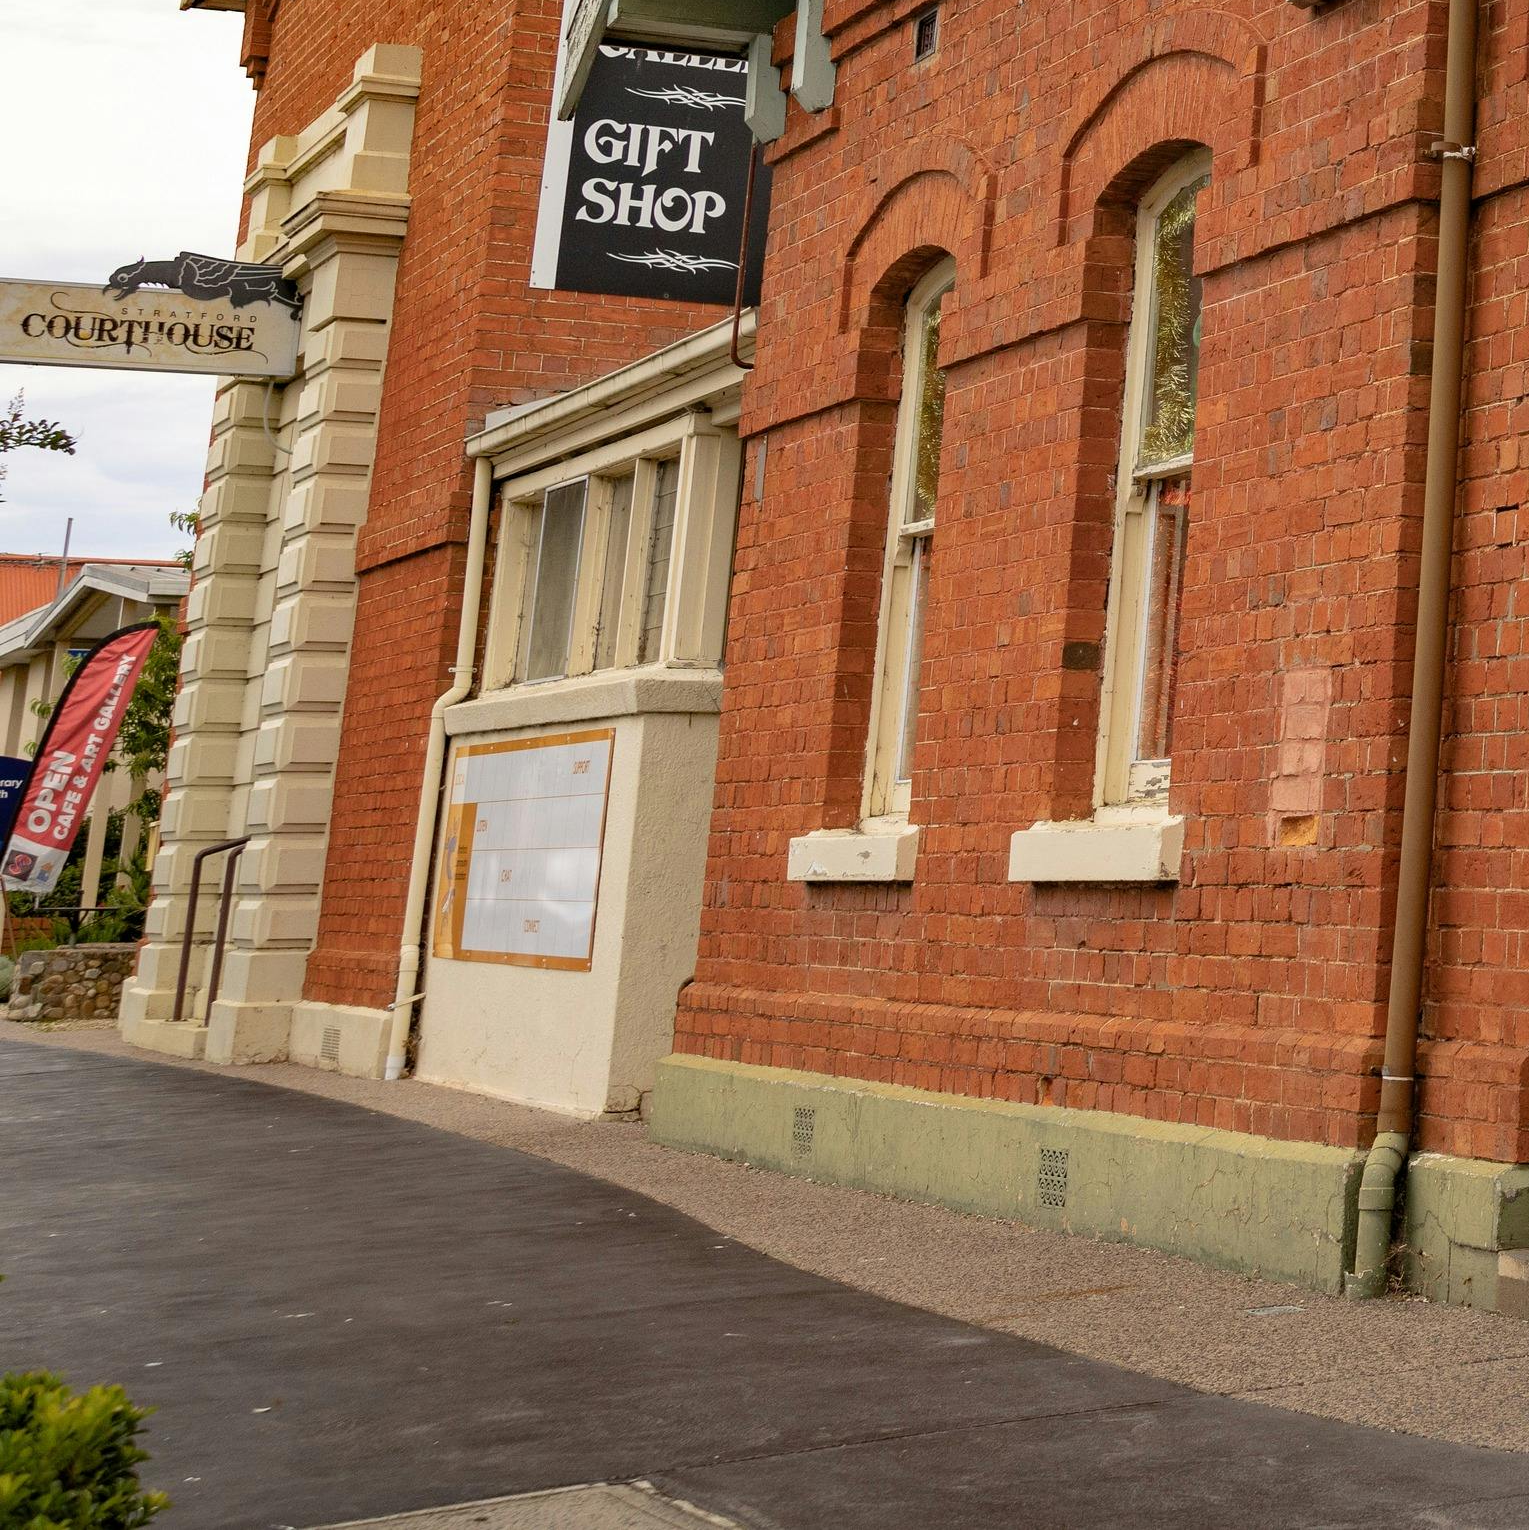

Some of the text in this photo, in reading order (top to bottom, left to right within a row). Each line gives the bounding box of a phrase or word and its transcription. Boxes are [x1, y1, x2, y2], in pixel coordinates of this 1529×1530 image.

[584, 118, 715, 177] GIFT
[575, 177, 727, 234] SHOP
[21, 312, 255, 354] COURTHOUSE
[121, 306, 258, 323] STRATFORD
[53, 653, 137, 840] CAFE & ART GALLERY
[27, 750, 76, 834] OPEN
